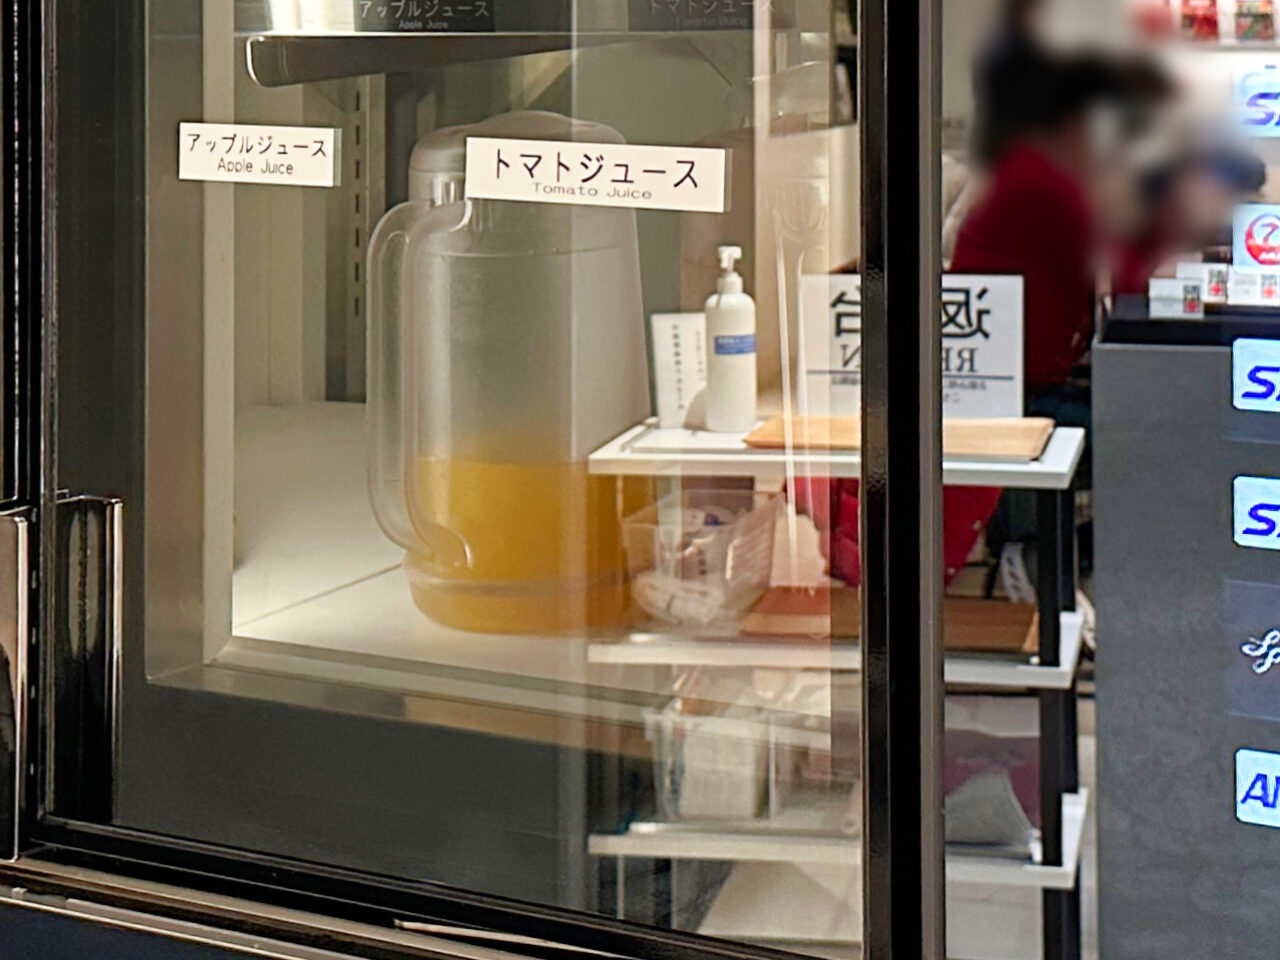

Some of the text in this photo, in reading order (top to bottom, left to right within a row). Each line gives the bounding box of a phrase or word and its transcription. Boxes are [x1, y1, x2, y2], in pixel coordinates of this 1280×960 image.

[187, 133, 327, 158] アップルジュース
[217, 157, 294, 175] Apple Juice
[496, 147, 698, 189] トマトジュース
[532, 182, 652, 200] Tomato Juice
